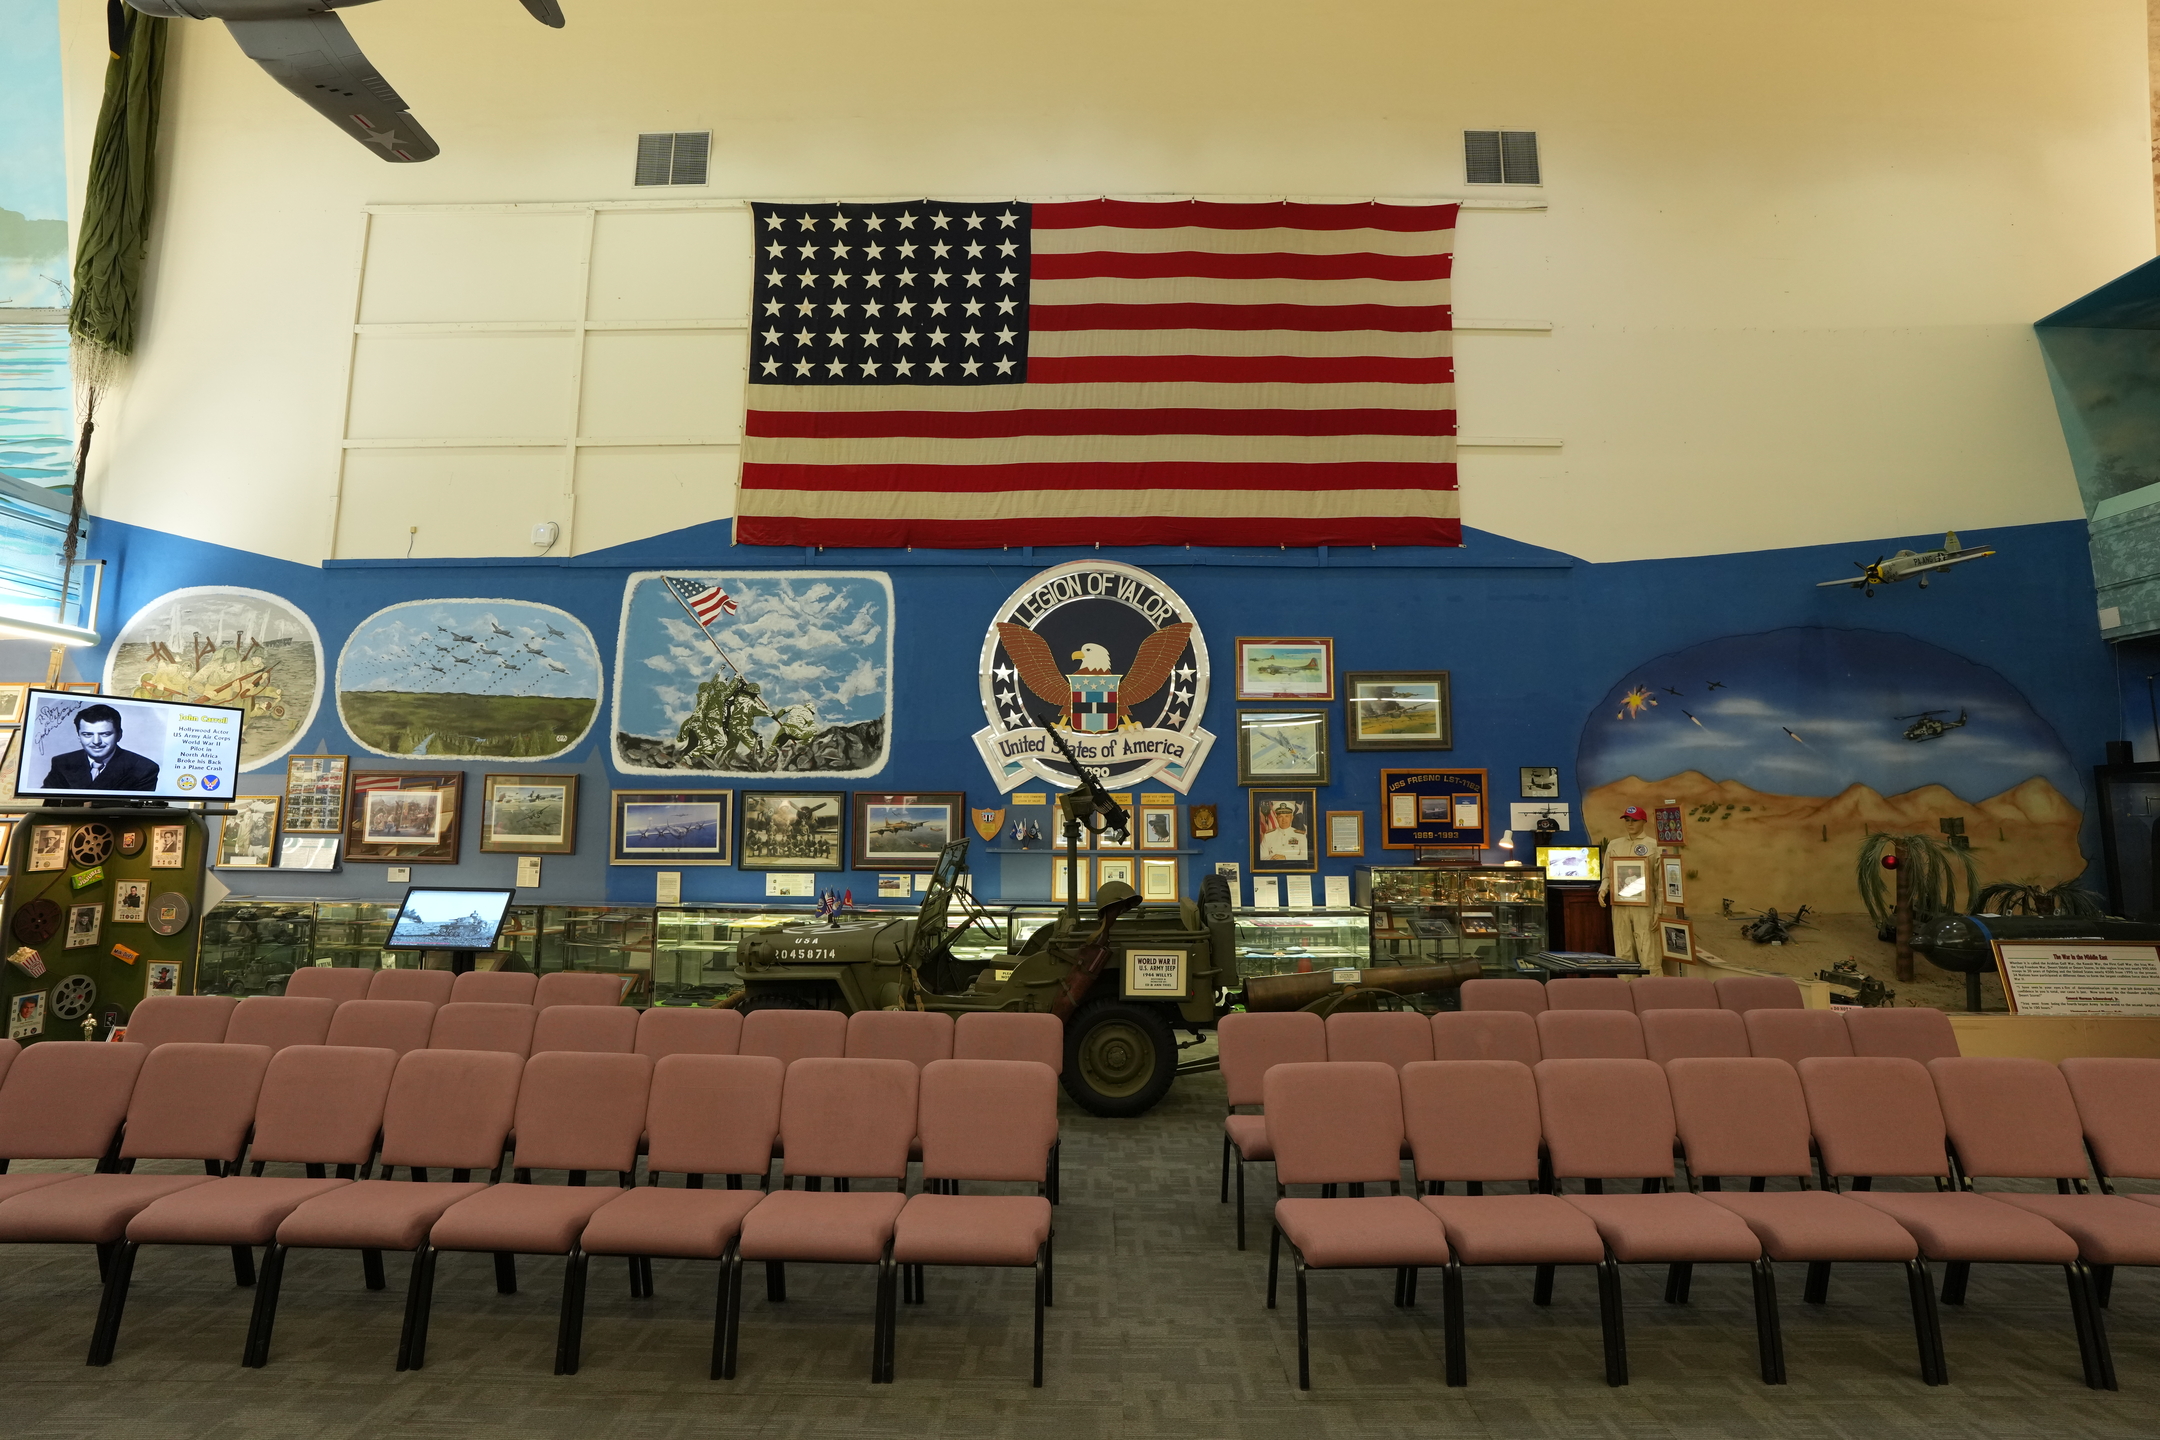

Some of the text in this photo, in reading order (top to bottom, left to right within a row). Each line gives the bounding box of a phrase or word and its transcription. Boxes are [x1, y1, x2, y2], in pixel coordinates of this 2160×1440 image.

[1014, 572, 1172, 628] LEGION OF VALOR
[201, 716, 228, 724] Carroll
[998, 735, 1185, 758] United Sates of America
[1389, 780, 1406, 791] USS
[1407, 775, 1440, 784] FRESNO
